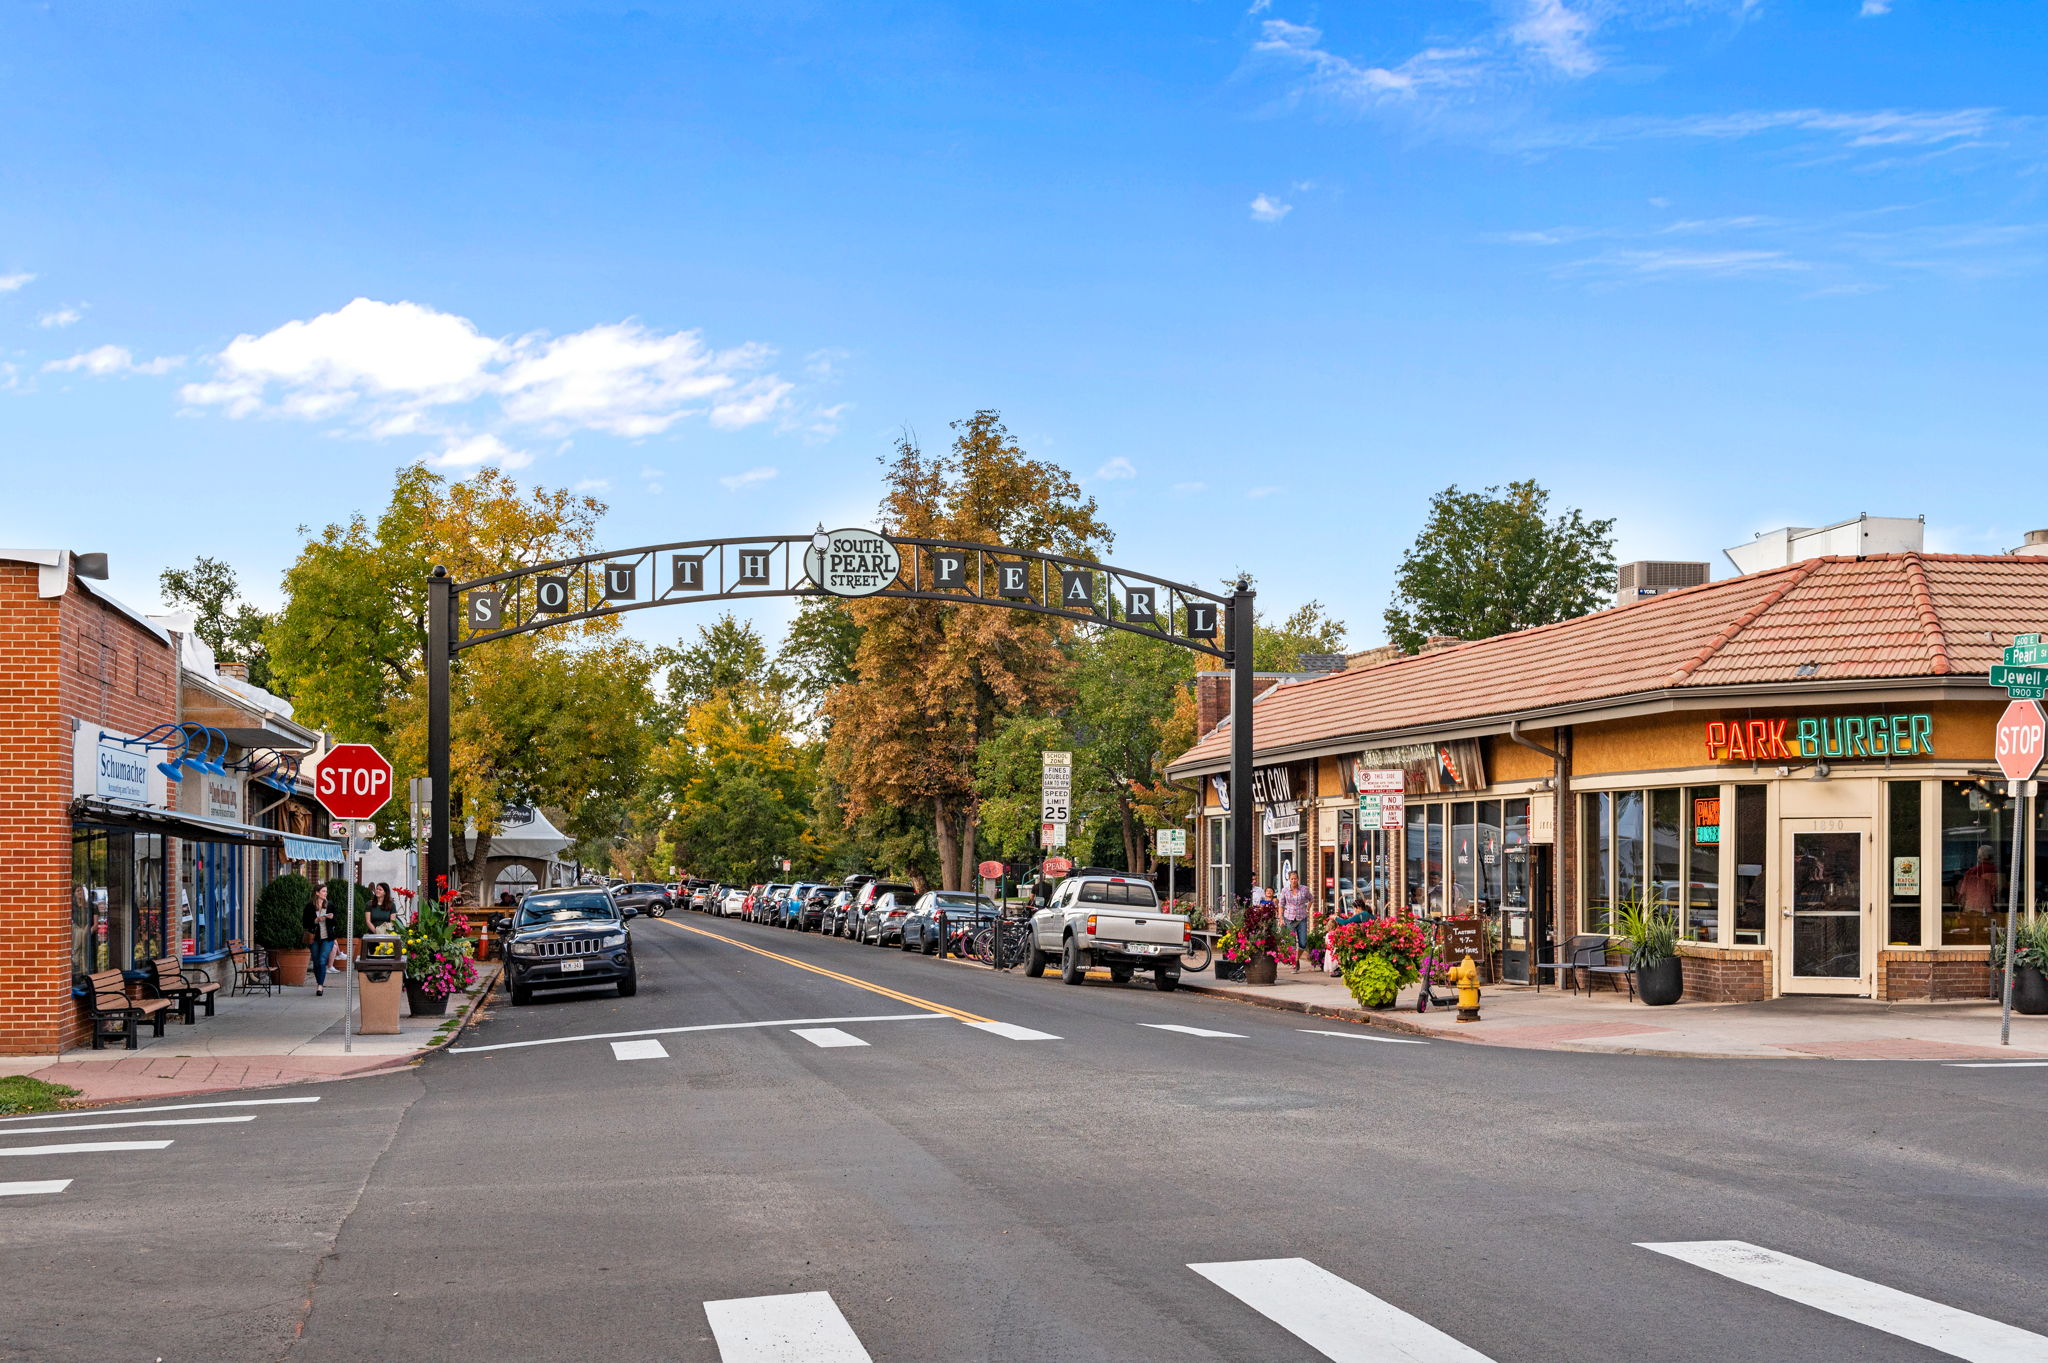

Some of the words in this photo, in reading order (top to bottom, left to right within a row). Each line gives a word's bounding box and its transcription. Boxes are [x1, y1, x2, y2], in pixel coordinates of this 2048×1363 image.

[834, 538, 884, 554] SOUTH
[830, 554, 896, 581] PEARL
[830, 575, 879, 589] STREET
[2017, 636, 2028, 645] 600
[2030, 635, 2034, 644] E
[2006, 653, 2009, 661] S
[2013, 647, 2037, 664] Pearl
[1998, 669, 2041, 686] Jewell
[2012, 689, 2031, 697] 1900
[2036, 690, 2041, 698] S
[1705, 719, 1792, 761] PARK
[1796, 713, 1935, 758] BURGER
[2000, 725, 2041, 756] STOP
[100, 752, 146, 784] Schumacher
[320, 767, 387, 796] STOP
[1267, 766, 1292, 801] COW
[1387, 796, 1397, 804] NO
[1045, 806, 1067, 820] 25
[1813, 819, 1844, 831] 1890
[1360, 854, 1369, 863] BEER
[1458, 855, 1469, 865] WINE
[1484, 854, 1495, 864] BEER
